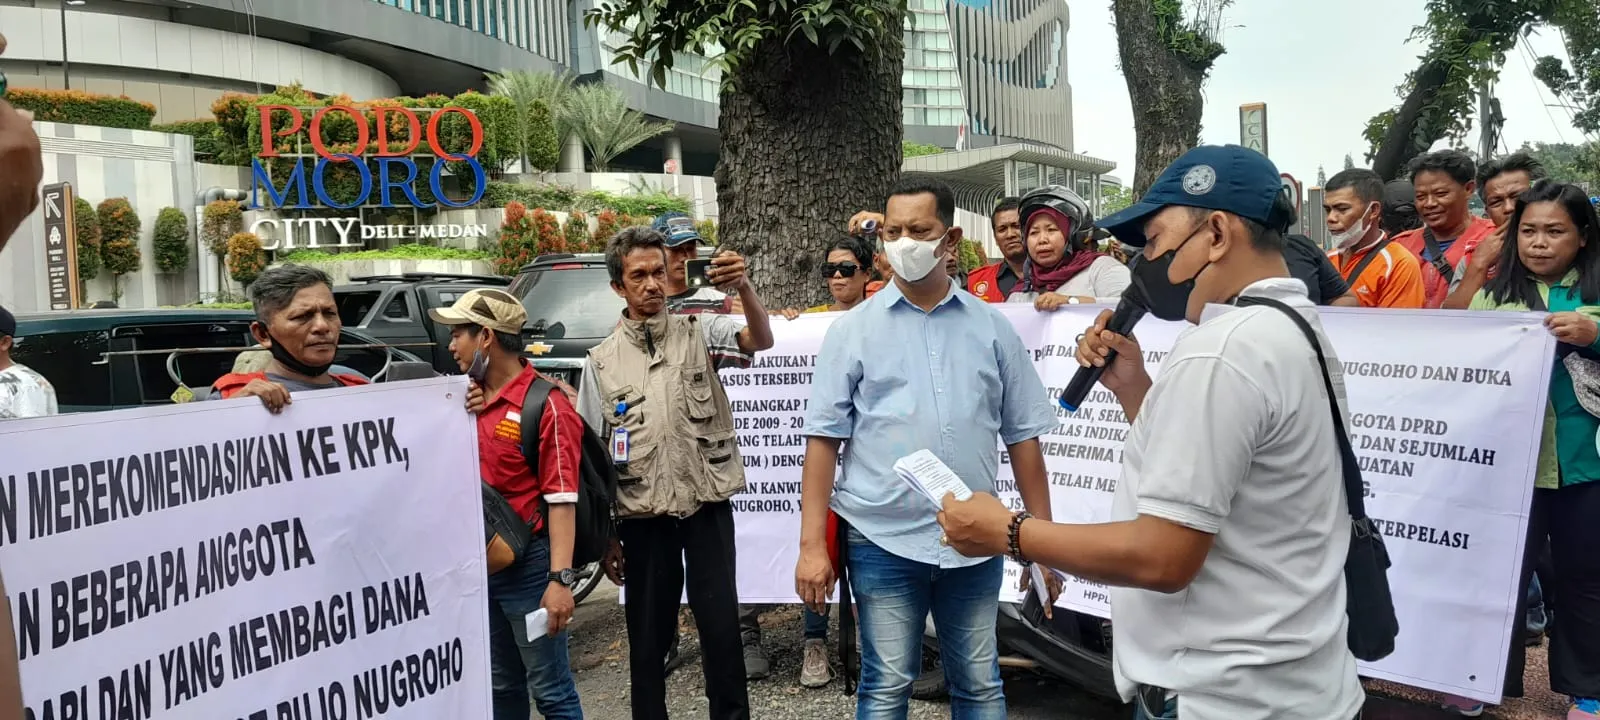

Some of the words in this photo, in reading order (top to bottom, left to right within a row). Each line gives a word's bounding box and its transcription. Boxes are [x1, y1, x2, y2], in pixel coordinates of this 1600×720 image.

[257, 104, 484, 162] PODO
[250, 153, 487, 209] MORO
[249, 217, 363, 251] CITY
[753, 372, 814, 386] TERSEBUT
[1421, 365, 1459, 382] DAN
[1461, 368, 1512, 386] BUKA
[752, 417, 780, 430] 2009
[1349, 412, 1396, 432] GOTA
[1400, 417, 1448, 435] DPRD
[762, 434, 802, 447] TELAH
[1360, 434, 1396, 453] DAN
[1398, 438, 1497, 467] SEJUMLAH
[27, 432, 293, 540] MEREKOMENDASIKAN
[296, 426, 341, 479] KE
[343, 417, 410, 473] KPK,
[1051, 471, 1094, 490] TELAH
[1358, 456, 1415, 477] UATAN
[1372, 518, 1470, 549] TERPELASI
[51, 547, 190, 650] BEBERAPA
[195, 517, 316, 601] ANGGOTA
[98, 659, 152, 720] DAN
[159, 632, 225, 711] YANG
[229, 591, 357, 680] MEMBAGI
[365, 572, 430, 635] DANA
[353, 637, 463, 720] NUGROHO
